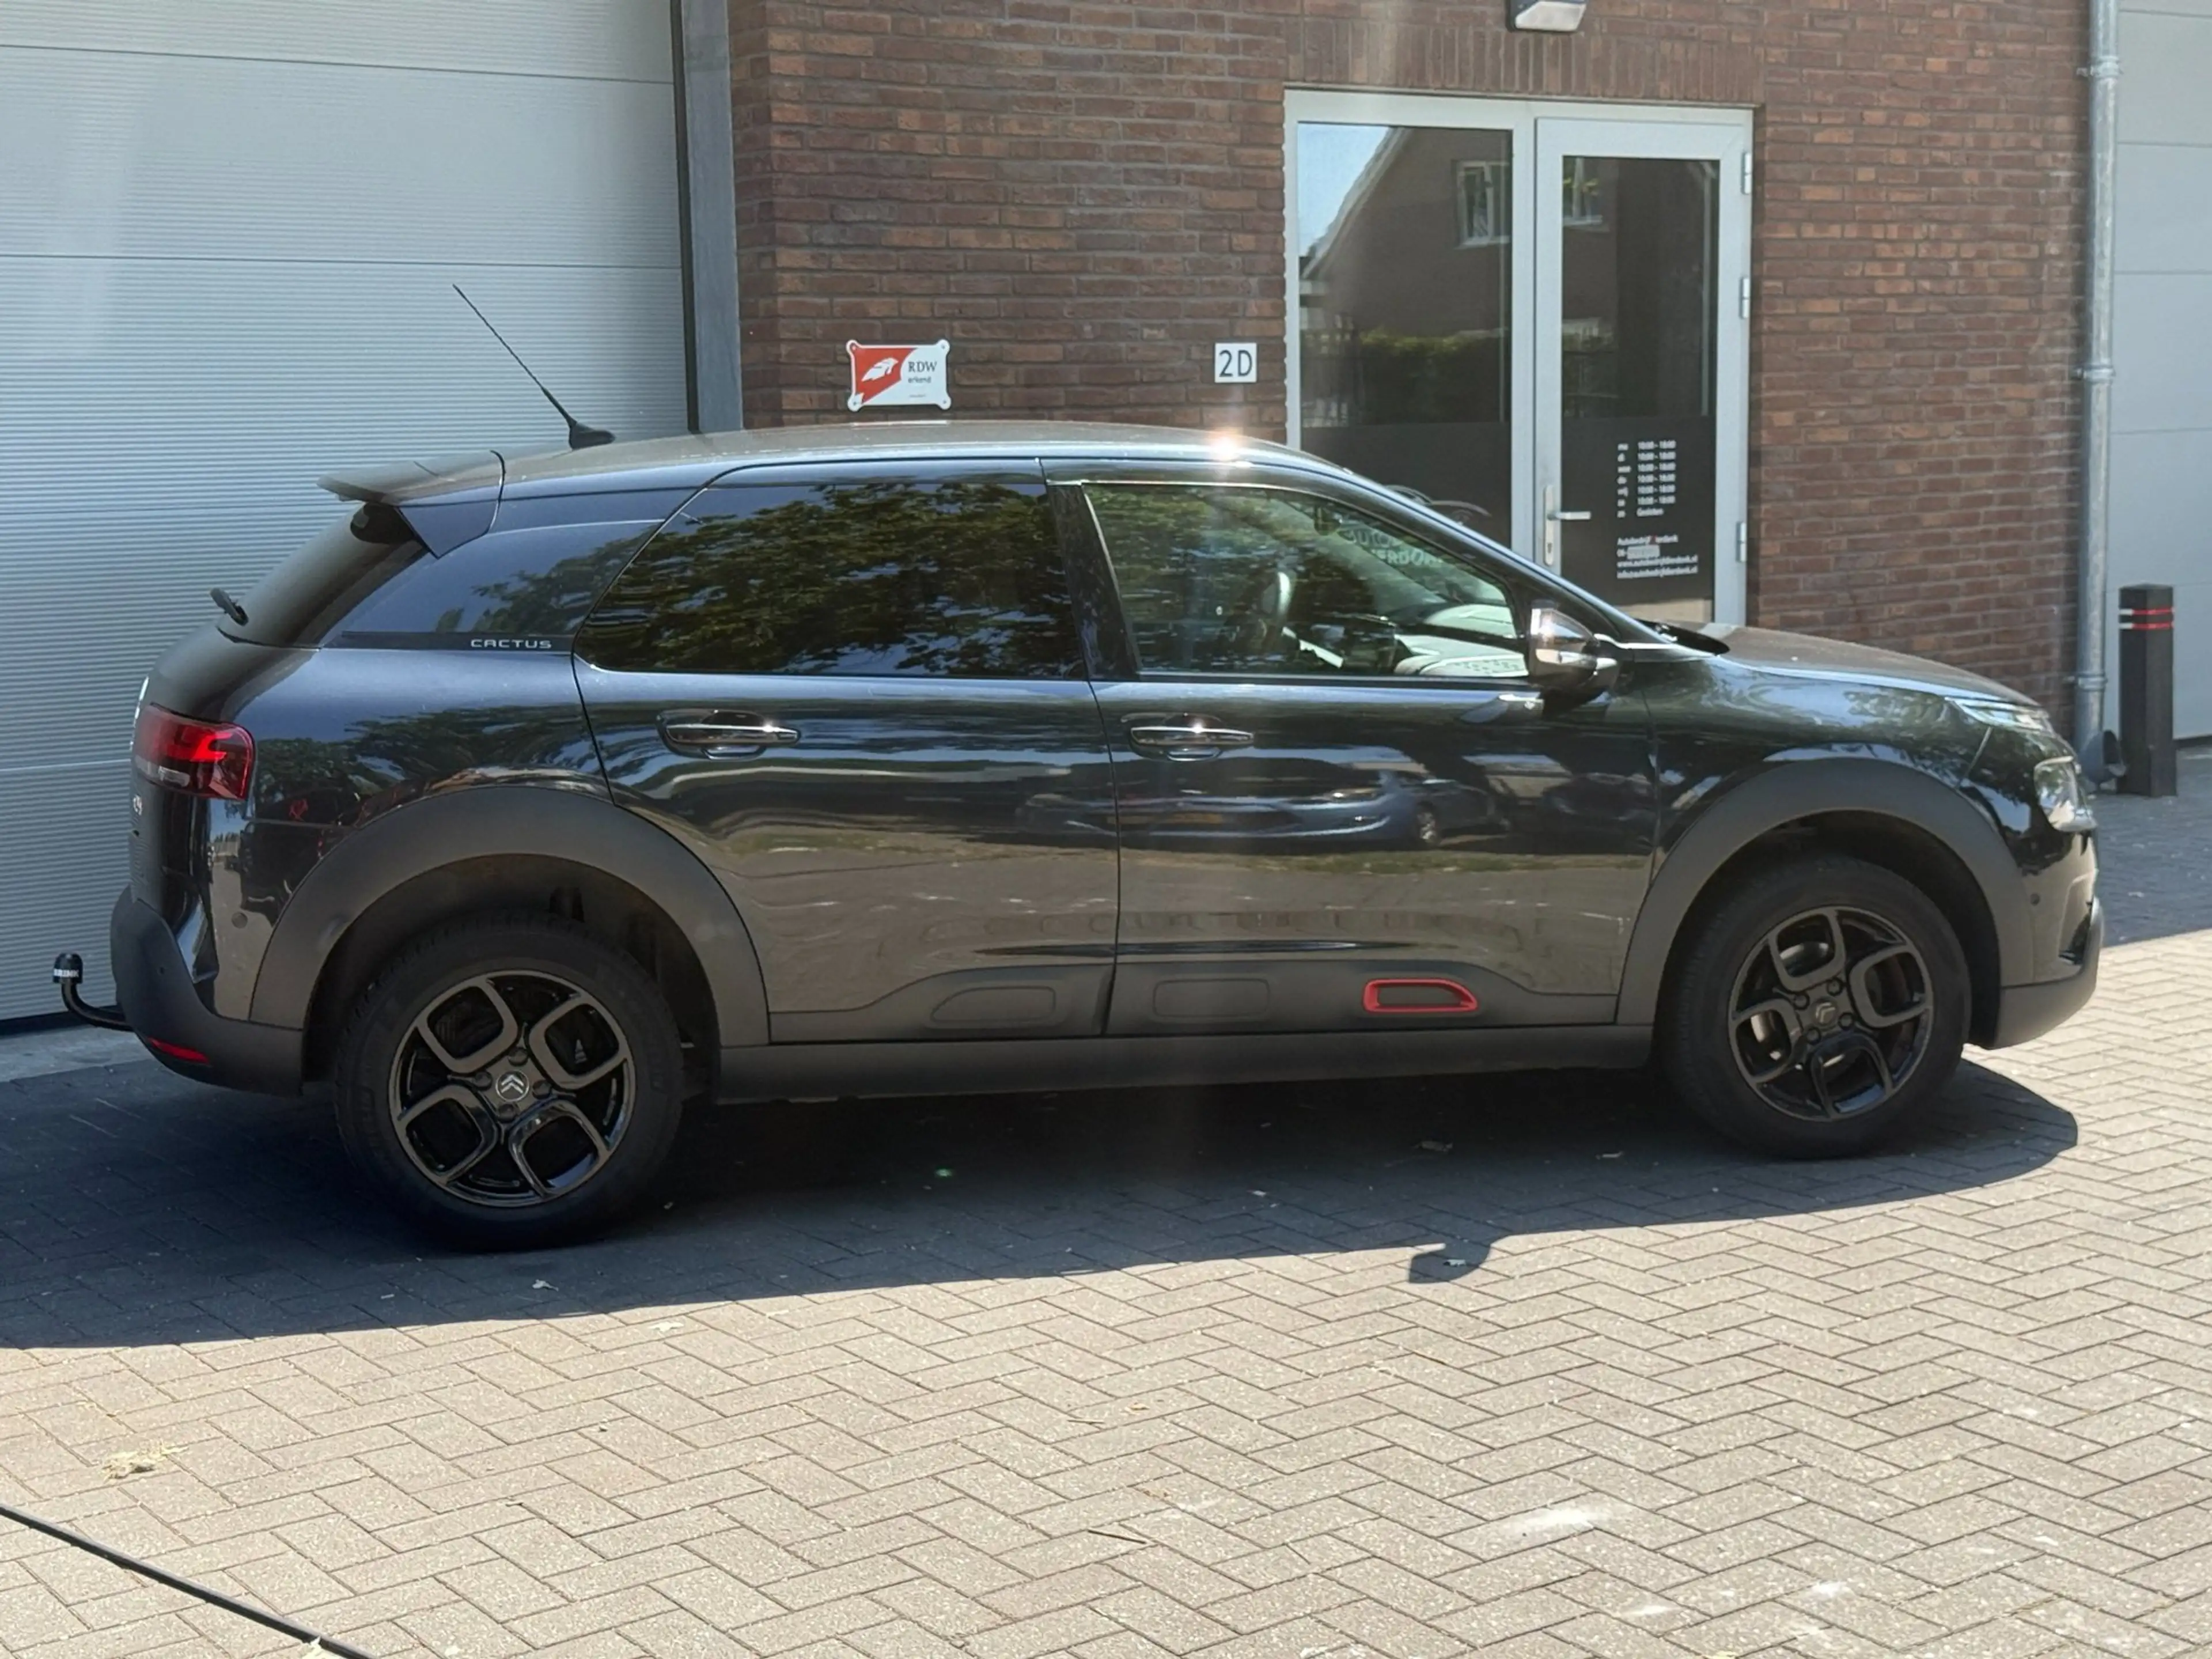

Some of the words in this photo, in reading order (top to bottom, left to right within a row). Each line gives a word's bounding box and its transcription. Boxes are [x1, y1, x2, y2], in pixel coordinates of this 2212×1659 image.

[907, 361, 938, 372] RDW
[1219, 349, 1252, 377] 2D
[470, 639, 552, 649] CACTUS
